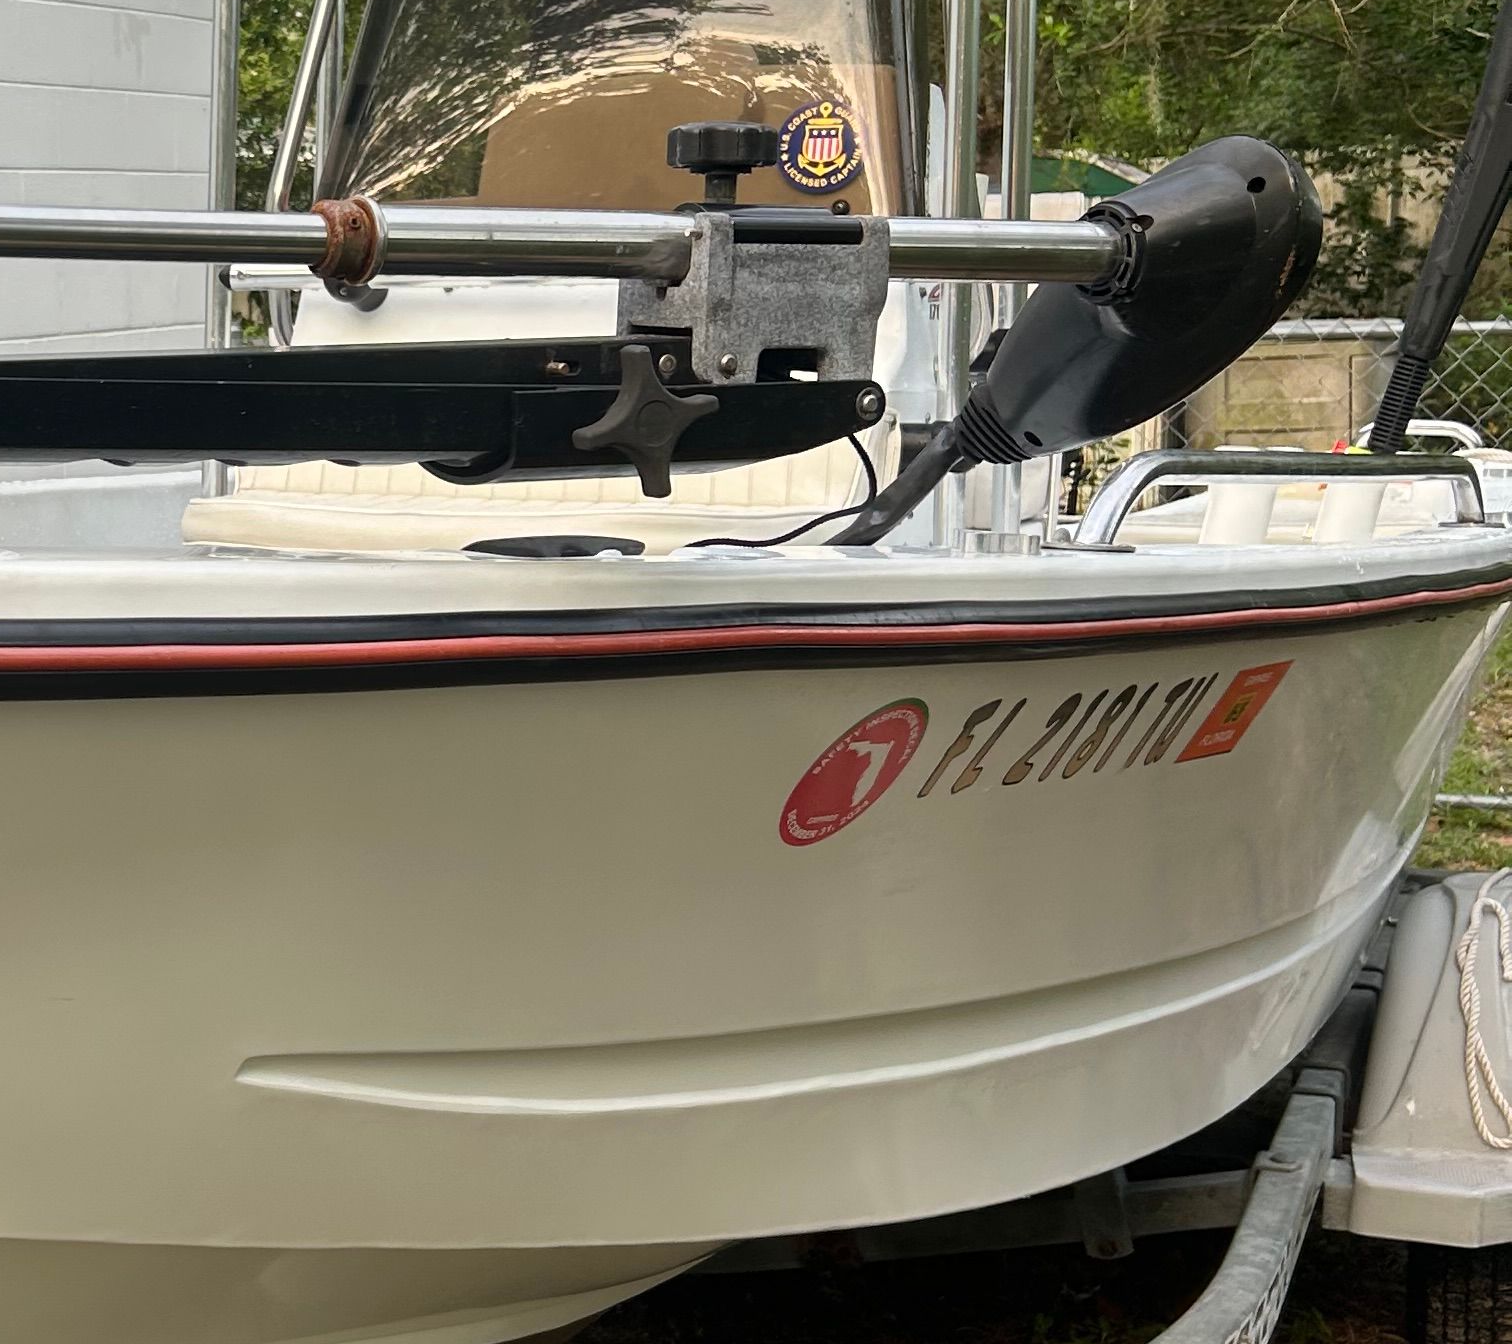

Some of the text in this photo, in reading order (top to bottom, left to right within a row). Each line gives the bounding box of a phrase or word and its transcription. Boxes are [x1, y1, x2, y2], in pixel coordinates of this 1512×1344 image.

[788, 107, 818, 131] COAST
[783, 147, 863, 188] LICENSED CAPTAIN
[916, 698, 1028, 798] FL
[1001, 681, 1160, 786] 2181
